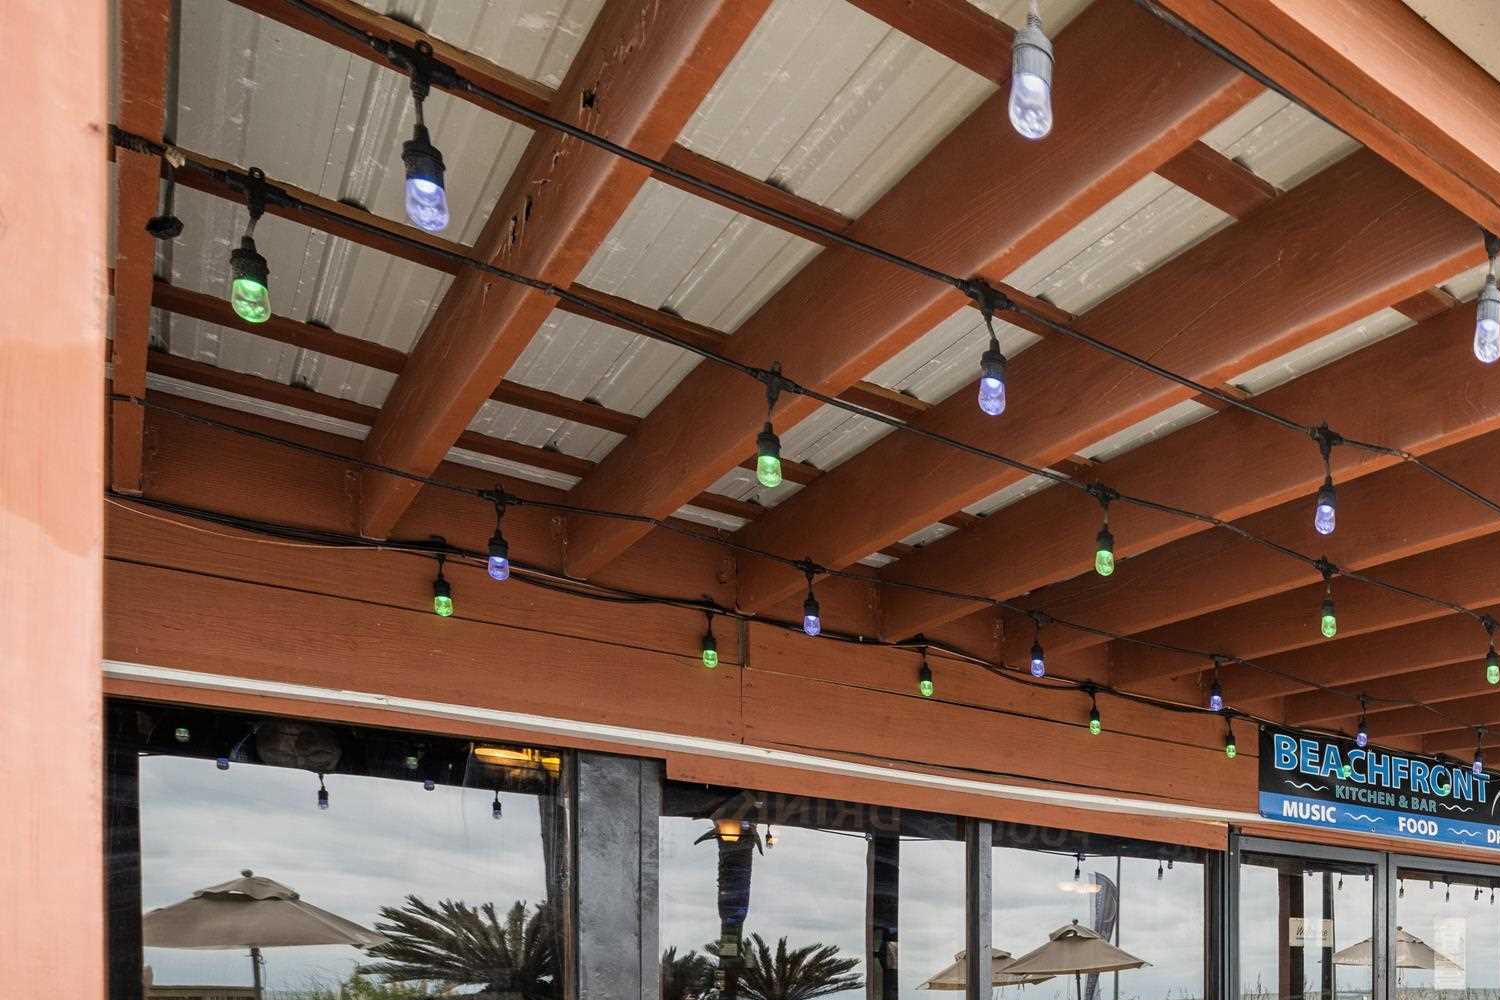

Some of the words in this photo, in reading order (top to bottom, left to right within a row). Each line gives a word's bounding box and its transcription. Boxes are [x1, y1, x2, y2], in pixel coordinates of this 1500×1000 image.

[1273, 733, 1490, 803] BEACHFRONT
[1335, 784, 1396, 807] KITCHEN
[1399, 796, 1409, 808] &
[1411, 797, 1437, 813] BAR
[1282, 800, 1337, 824] MUSIC
[1398, 816, 1438, 837] FOOD
